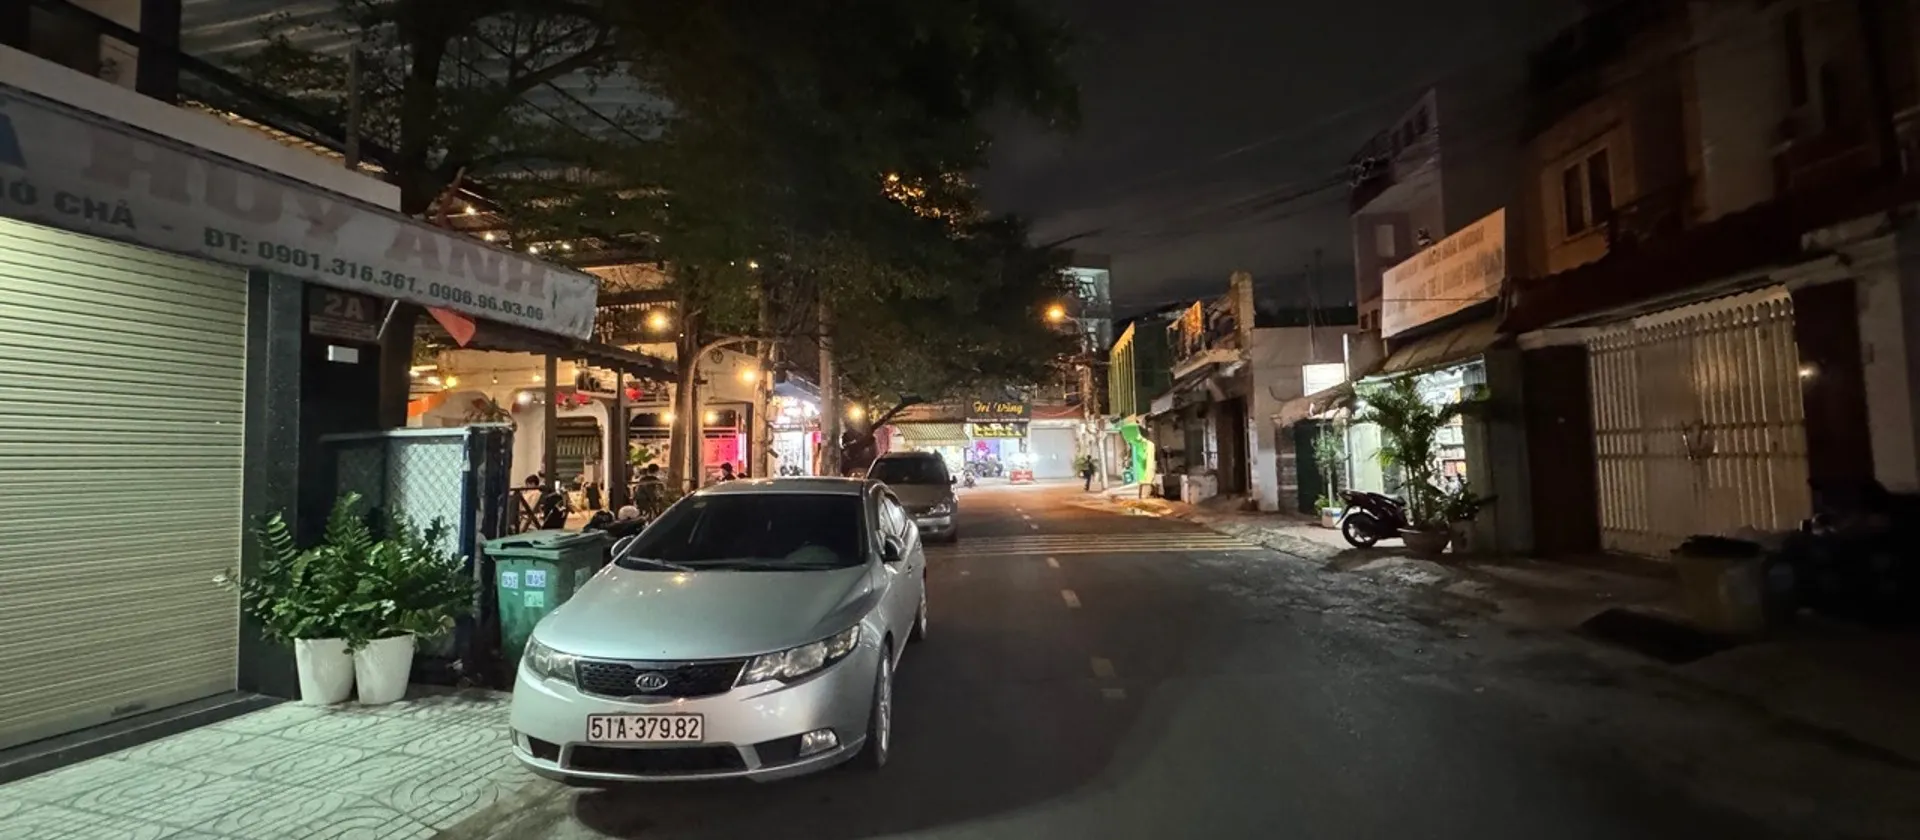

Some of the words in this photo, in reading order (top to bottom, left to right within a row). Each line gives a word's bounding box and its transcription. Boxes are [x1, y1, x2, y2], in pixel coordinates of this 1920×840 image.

[53, 190, 137, 229] CHẢ
[203, 226, 248, 254] ĐT:
[81, 126, 350, 236] HUY
[384, 226, 546, 296] ANH
[324, 292, 364, 320] 2A
[640, 676, 661, 688] KIA
[591, 717, 699, 739] 51A-379.82
